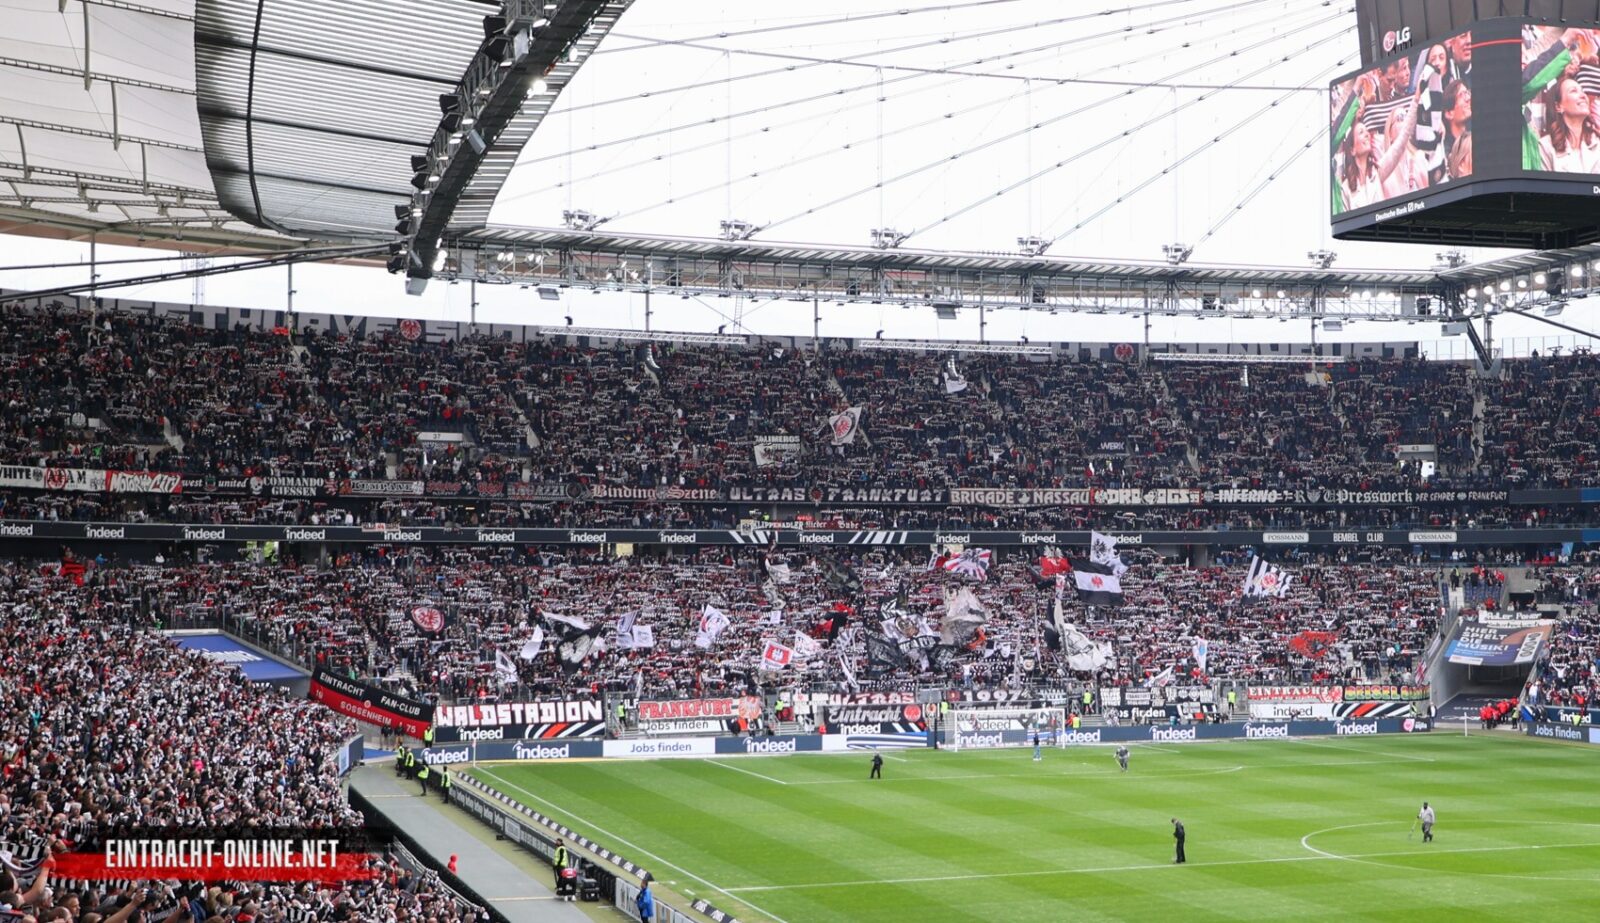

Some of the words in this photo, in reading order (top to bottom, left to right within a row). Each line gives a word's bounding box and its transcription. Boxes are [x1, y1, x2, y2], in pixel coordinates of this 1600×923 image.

[1396, 26, 1411, 45] LG
[1376, 209, 1395, 221] Deutsche
[1396, 206, 1408, 216] Bank
[1414, 202, 1425, 211] Park
[182, 478, 203, 487] west
[217, 477, 249, 488] united
[263, 476, 324, 487] COMMANDO
[271, 487, 317, 497] GIESSEN
[591, 484, 656, 500] Binding
[730, 487, 805, 500] ULTRAS
[827, 488, 945, 501] FRANKFURT
[951, 491, 1015, 504] BRIGADE
[1033, 491, 1090, 504] NASSAU
[1219, 489, 1277, 503] INFERNO
[1468, 490, 1508, 501] FRANKFURT
[0, 524, 33, 536] indeed
[87, 526, 125, 538] indeed
[185, 529, 225, 539] indeed
[286, 529, 326, 539] indeed
[384, 530, 421, 541] indeed
[478, 531, 515, 541] indeed
[570, 531, 606, 542] indeed
[660, 532, 696, 543] indeed
[799, 532, 834, 543] indeed
[936, 533, 970, 544] indeed
[1333, 533, 1359, 542] BEMBEL
[1366, 533, 1384, 542] CLUB
[1462, 632, 1509, 640] SPIELT
[1464, 626, 1498, 634] HIER
[319, 671, 365, 697] EINTRACHT
[380, 695, 421, 716] FAN-CLUB
[963, 689, 1022, 702] 1997
[1250, 686, 1329, 697] EINTRACHT
[340, 700, 391, 726] SOSSENHEIM
[436, 700, 603, 727] WALDSTADION
[639, 699, 733, 718] FRANKFURT
[828, 705, 901, 723] Eintracht
[1560, 711, 1591, 724] inded
[406, 723, 416, 734] 75
[645, 720, 671, 731] Jobs
[674, 719, 708, 730] finden
[840, 723, 881, 735] indeed
[1246, 723, 1288, 737] indeed
[1337, 721, 1377, 734] indeed
[460, 726, 503, 741] indeed
[956, 732, 1003, 744] indeed
[1056, 729, 1101, 743] indeed
[1152, 726, 1196, 740] indeed
[1535, 725, 1554, 737] Jobs
[1555, 727, 1582, 740] finden
[630, 742, 655, 753] Jobs
[658, 742, 692, 752] finden
[747, 737, 796, 752] indeed
[425, 747, 469, 764] indeed
[516, 743, 569, 759] indeed
